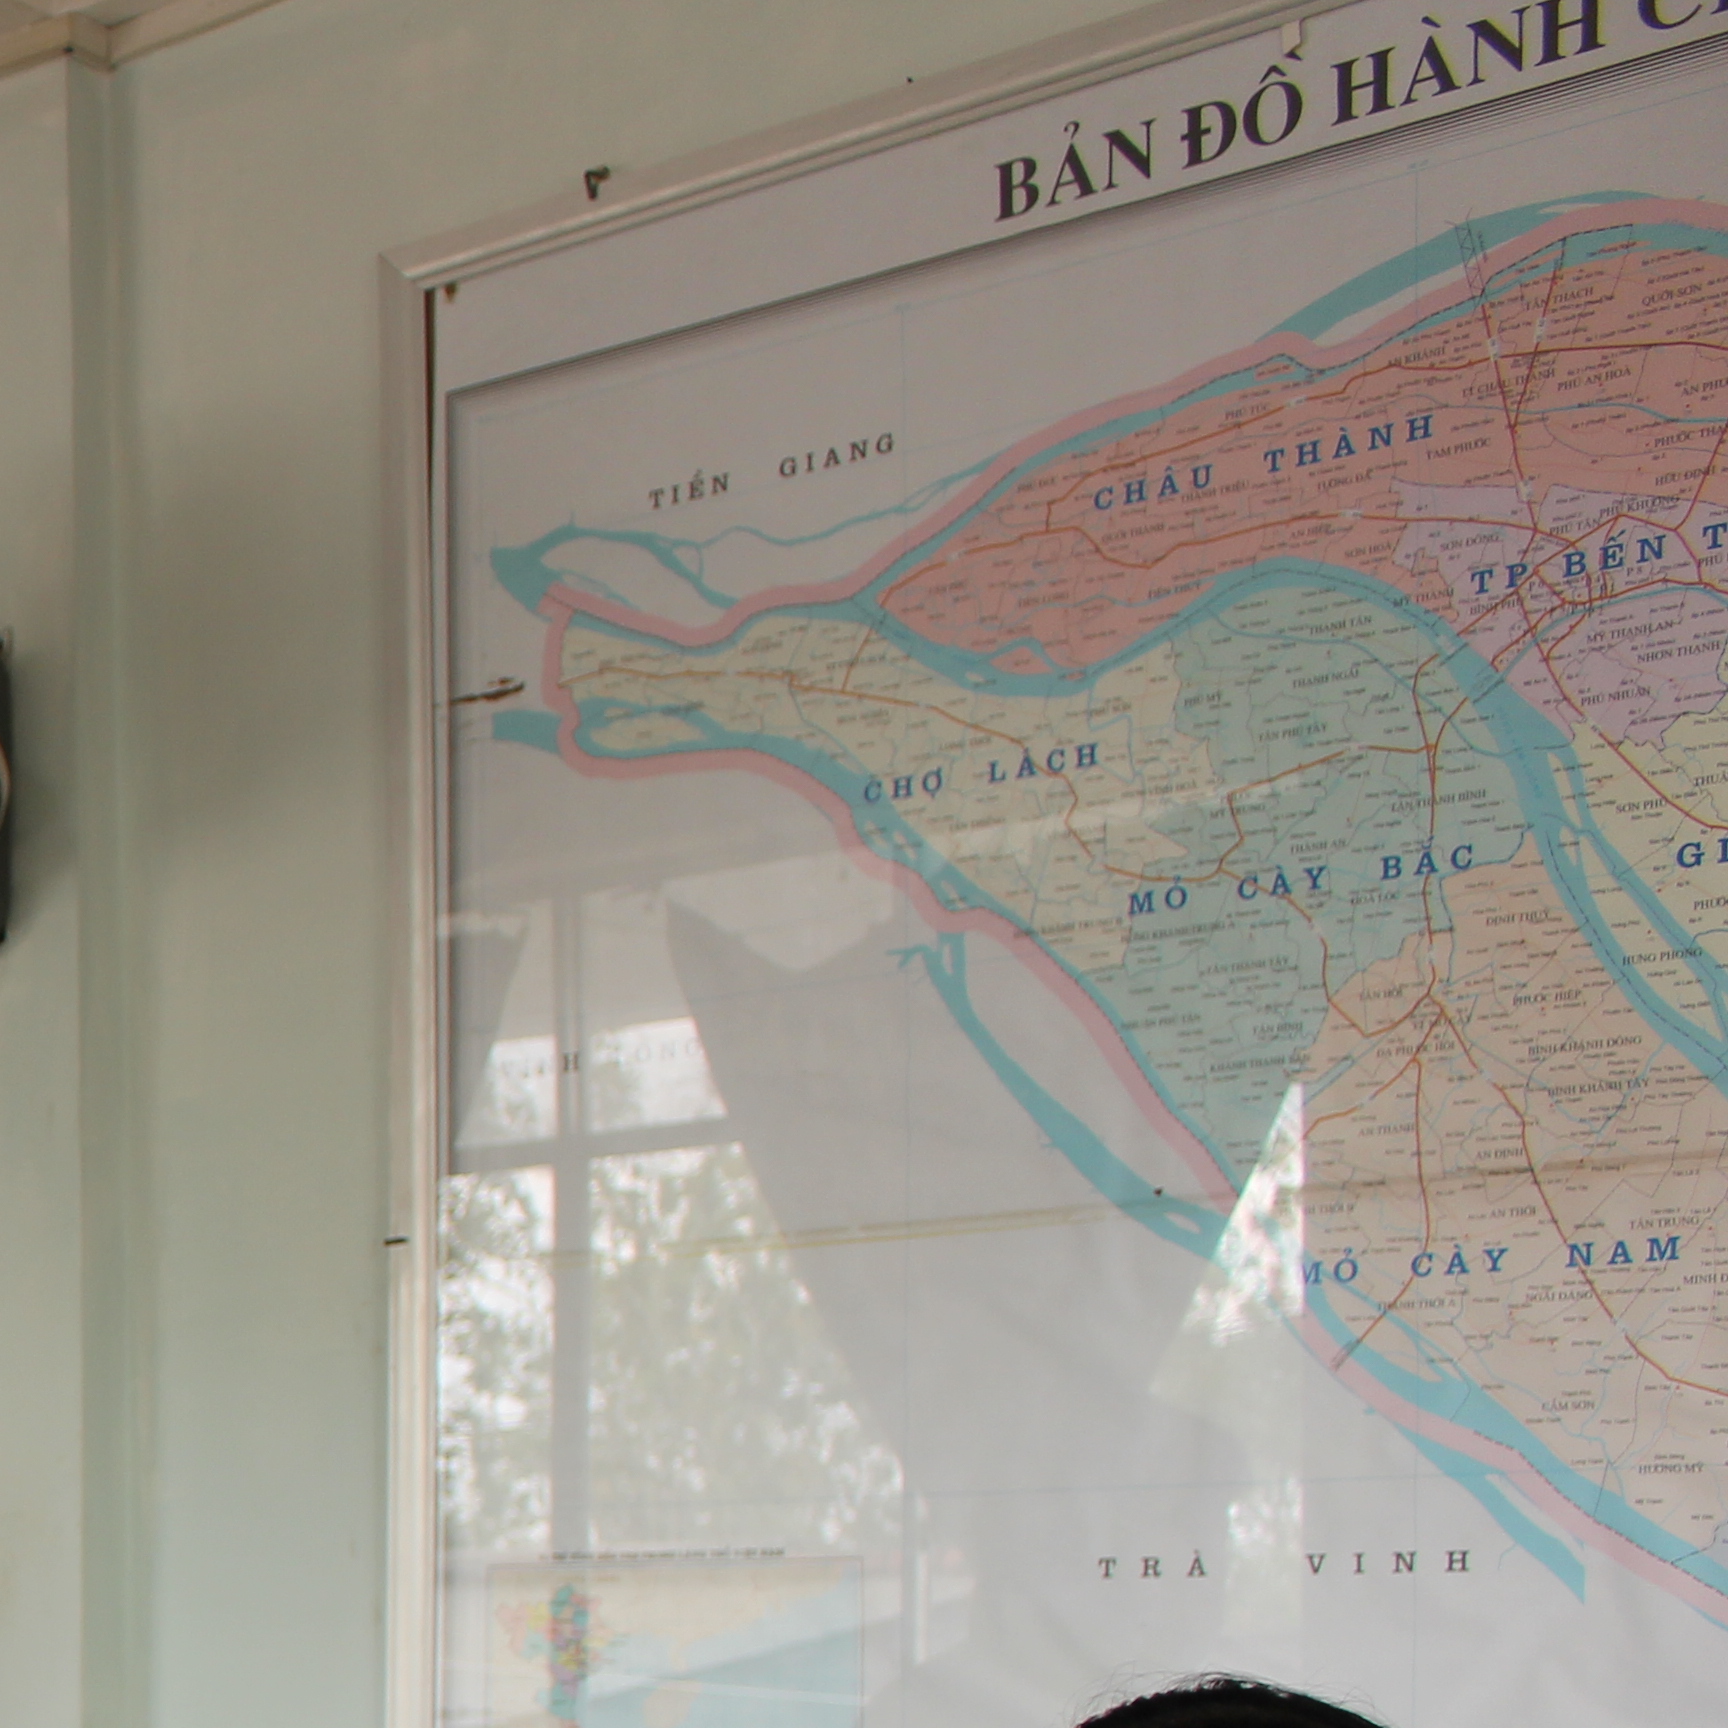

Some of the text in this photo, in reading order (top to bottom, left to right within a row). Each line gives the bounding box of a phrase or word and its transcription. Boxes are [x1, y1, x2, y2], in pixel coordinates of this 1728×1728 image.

[994, 0, 1608, 222] BẢN ĐỒ HÀNH
[778, 432, 895, 478] GIANG
[1093, 414, 1434, 511] CHÂU THÀNH
[1562, 528, 1667, 579] BẾN
[864, 767, 944, 805] CHỢ
[1128, 835, 1475, 916] MỎ CÀY BẮC
[1410, 1242, 1509, 1277] CÀY
[1564, 1235, 1682, 1269] NAM
[1098, 1550, 1470, 1579] TRÀ VINH
